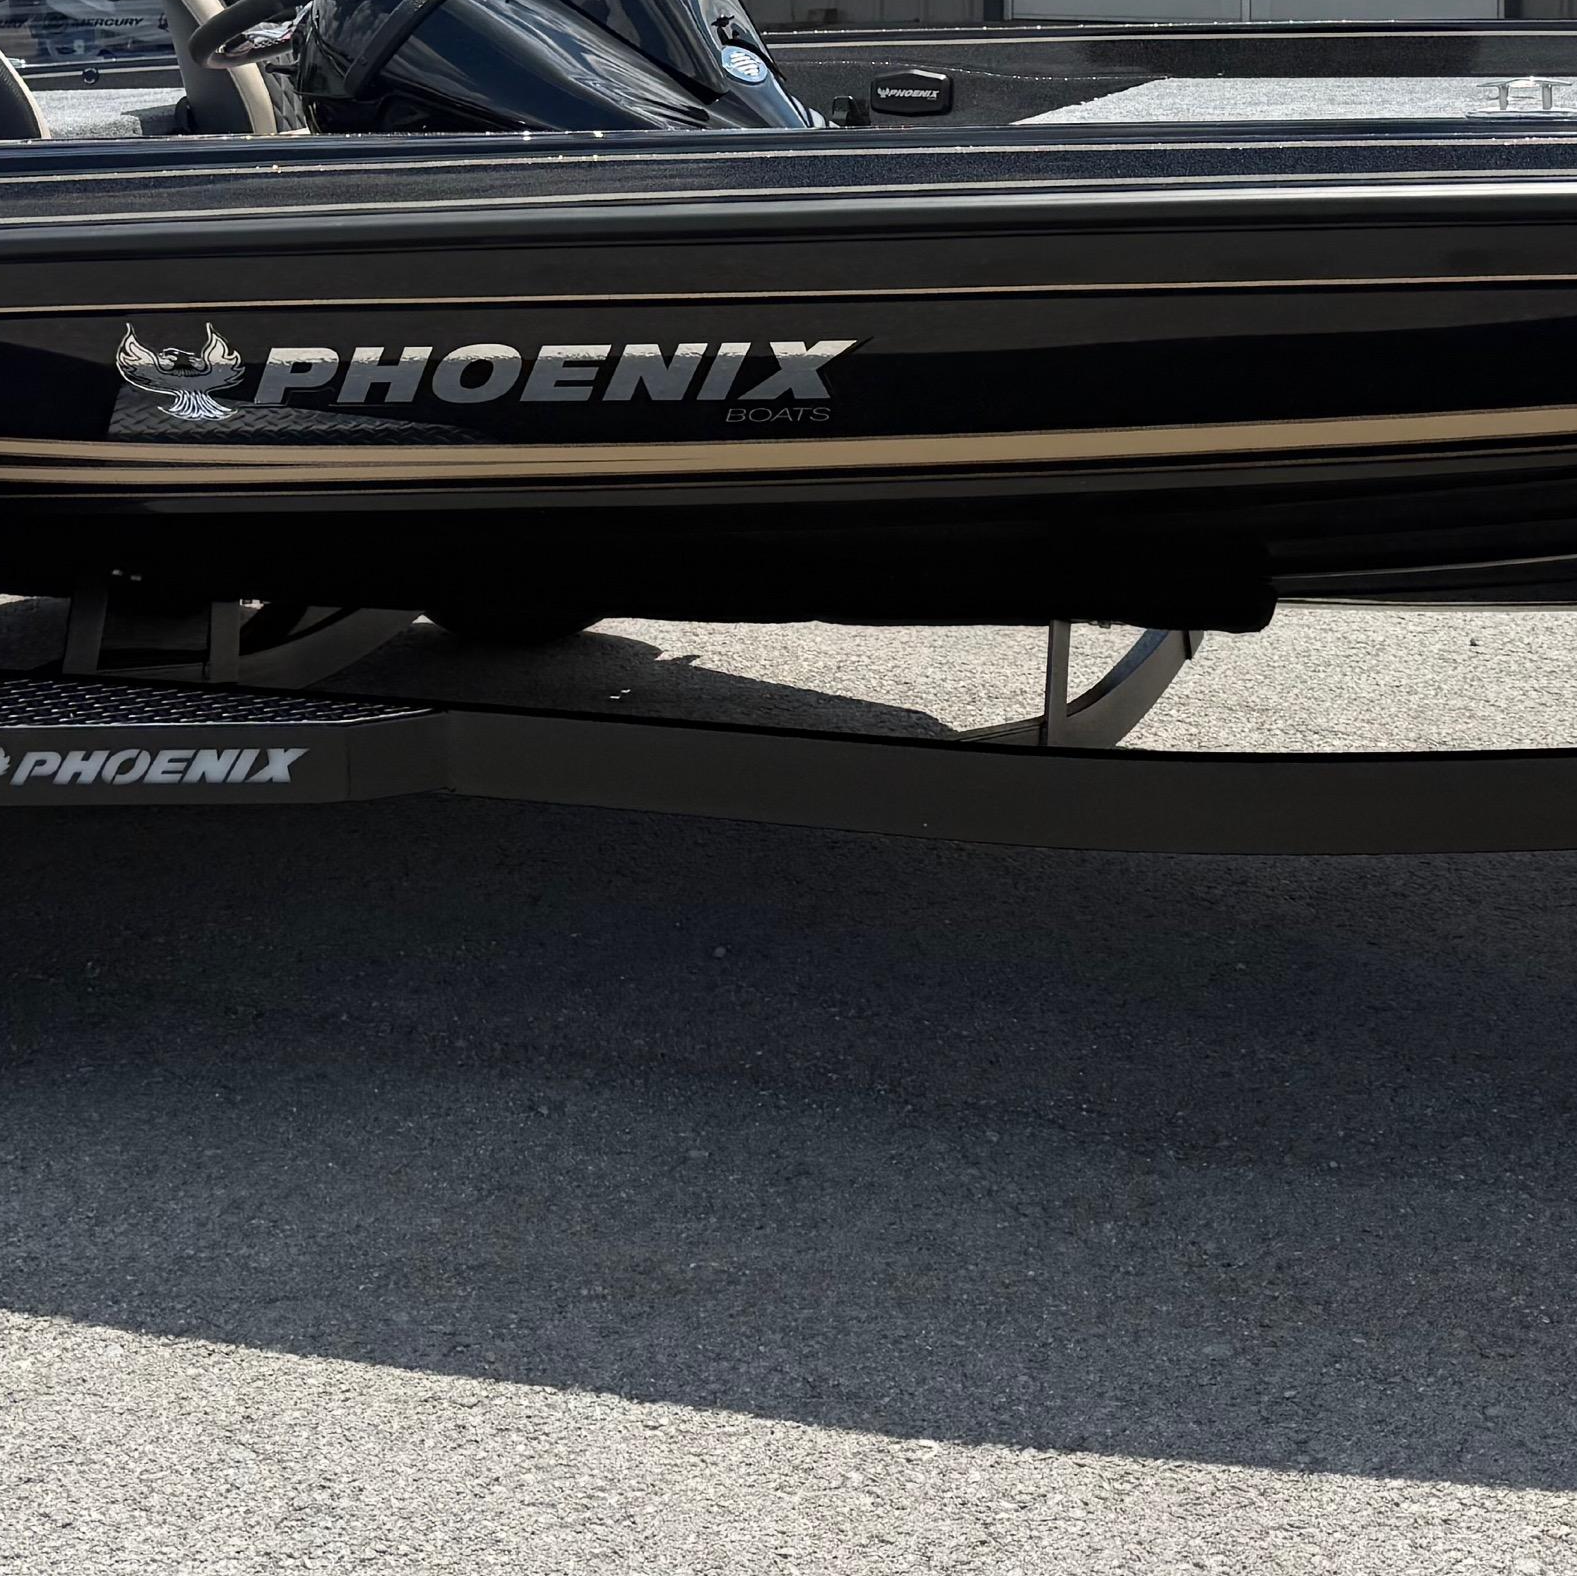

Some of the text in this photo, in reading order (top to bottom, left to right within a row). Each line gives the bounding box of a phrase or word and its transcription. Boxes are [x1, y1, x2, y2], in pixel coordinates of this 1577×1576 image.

[888, 89, 939, 98] PHOENIX
[254, 340, 861, 405] PHOENIX
[725, 407, 831, 423] BOATS
[9, 747, 311, 785] PHOENIX
